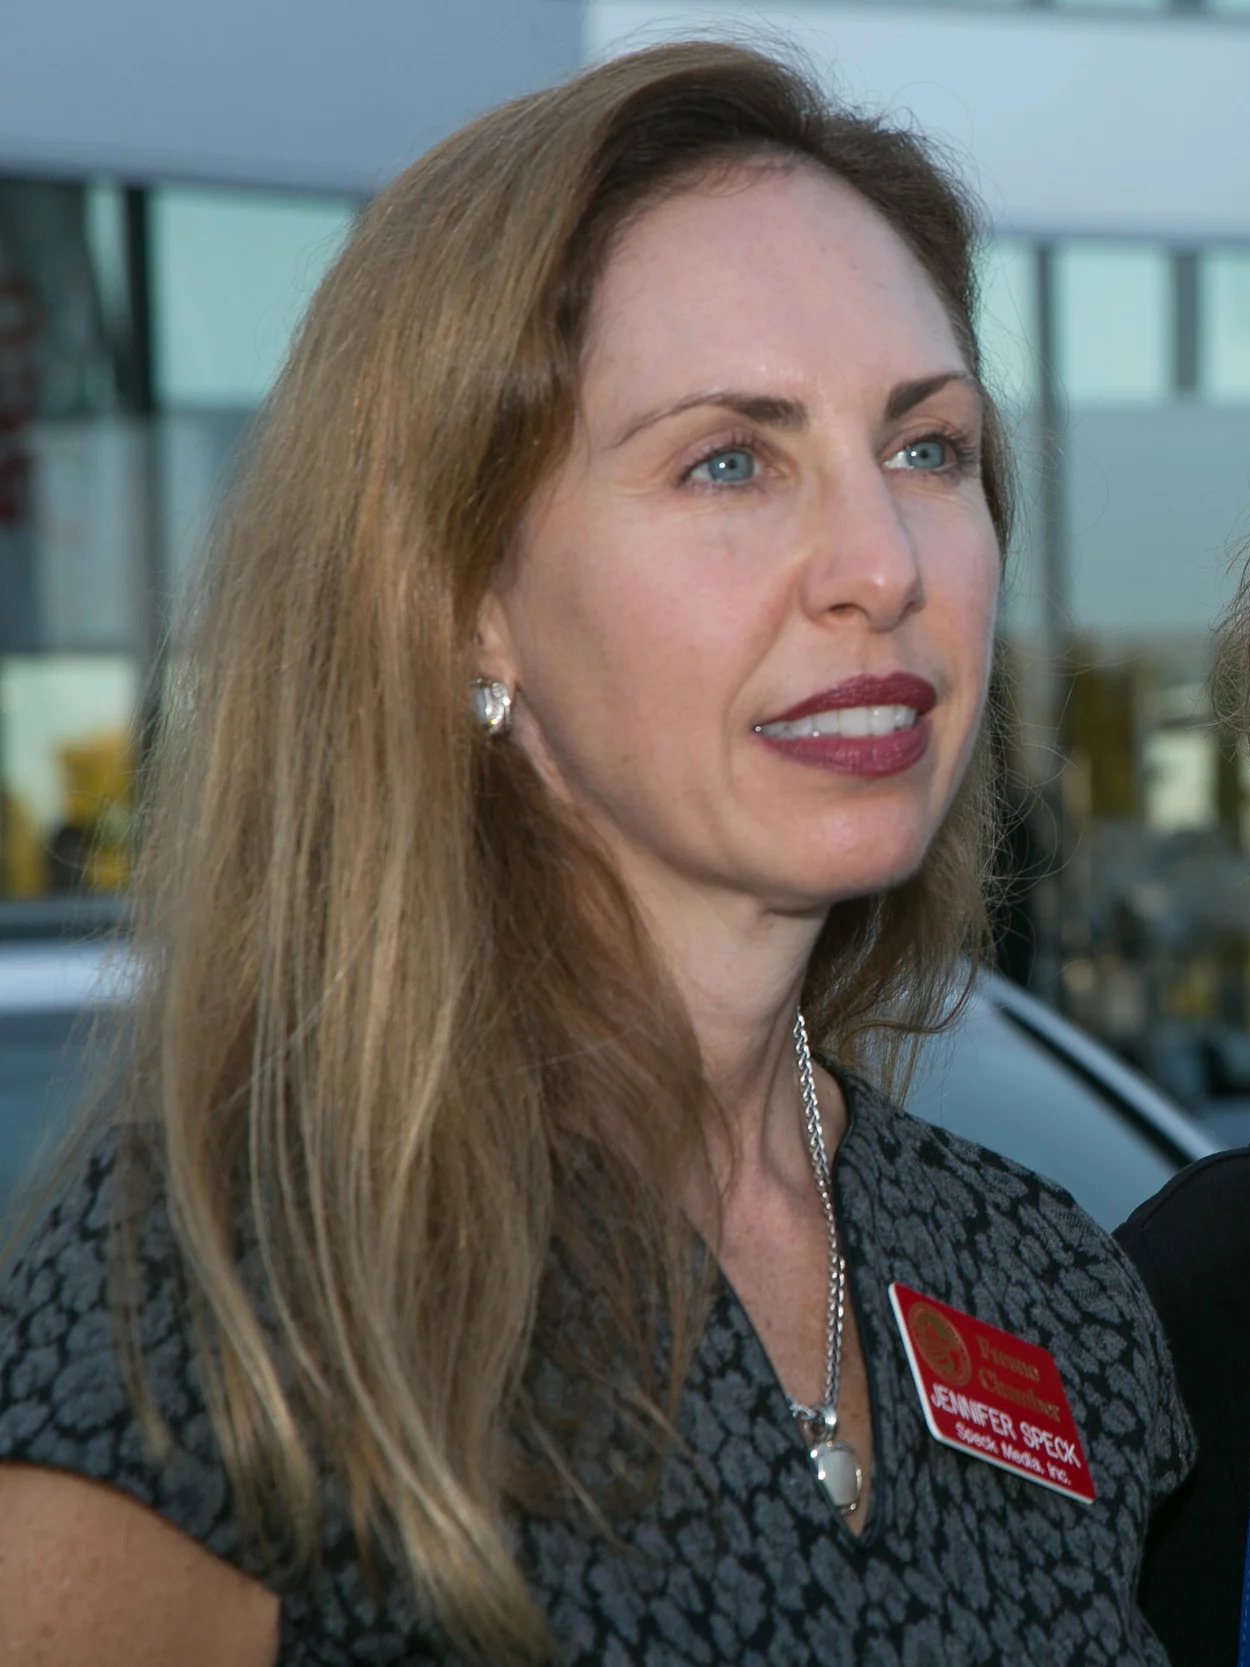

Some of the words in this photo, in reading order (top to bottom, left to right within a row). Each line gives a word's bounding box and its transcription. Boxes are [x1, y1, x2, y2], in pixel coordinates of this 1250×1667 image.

[931, 1383, 1017, 1440] JENNIFER
[1020, 1421, 1082, 1468] SPECK
[955, 1422, 998, 1454] Speck
